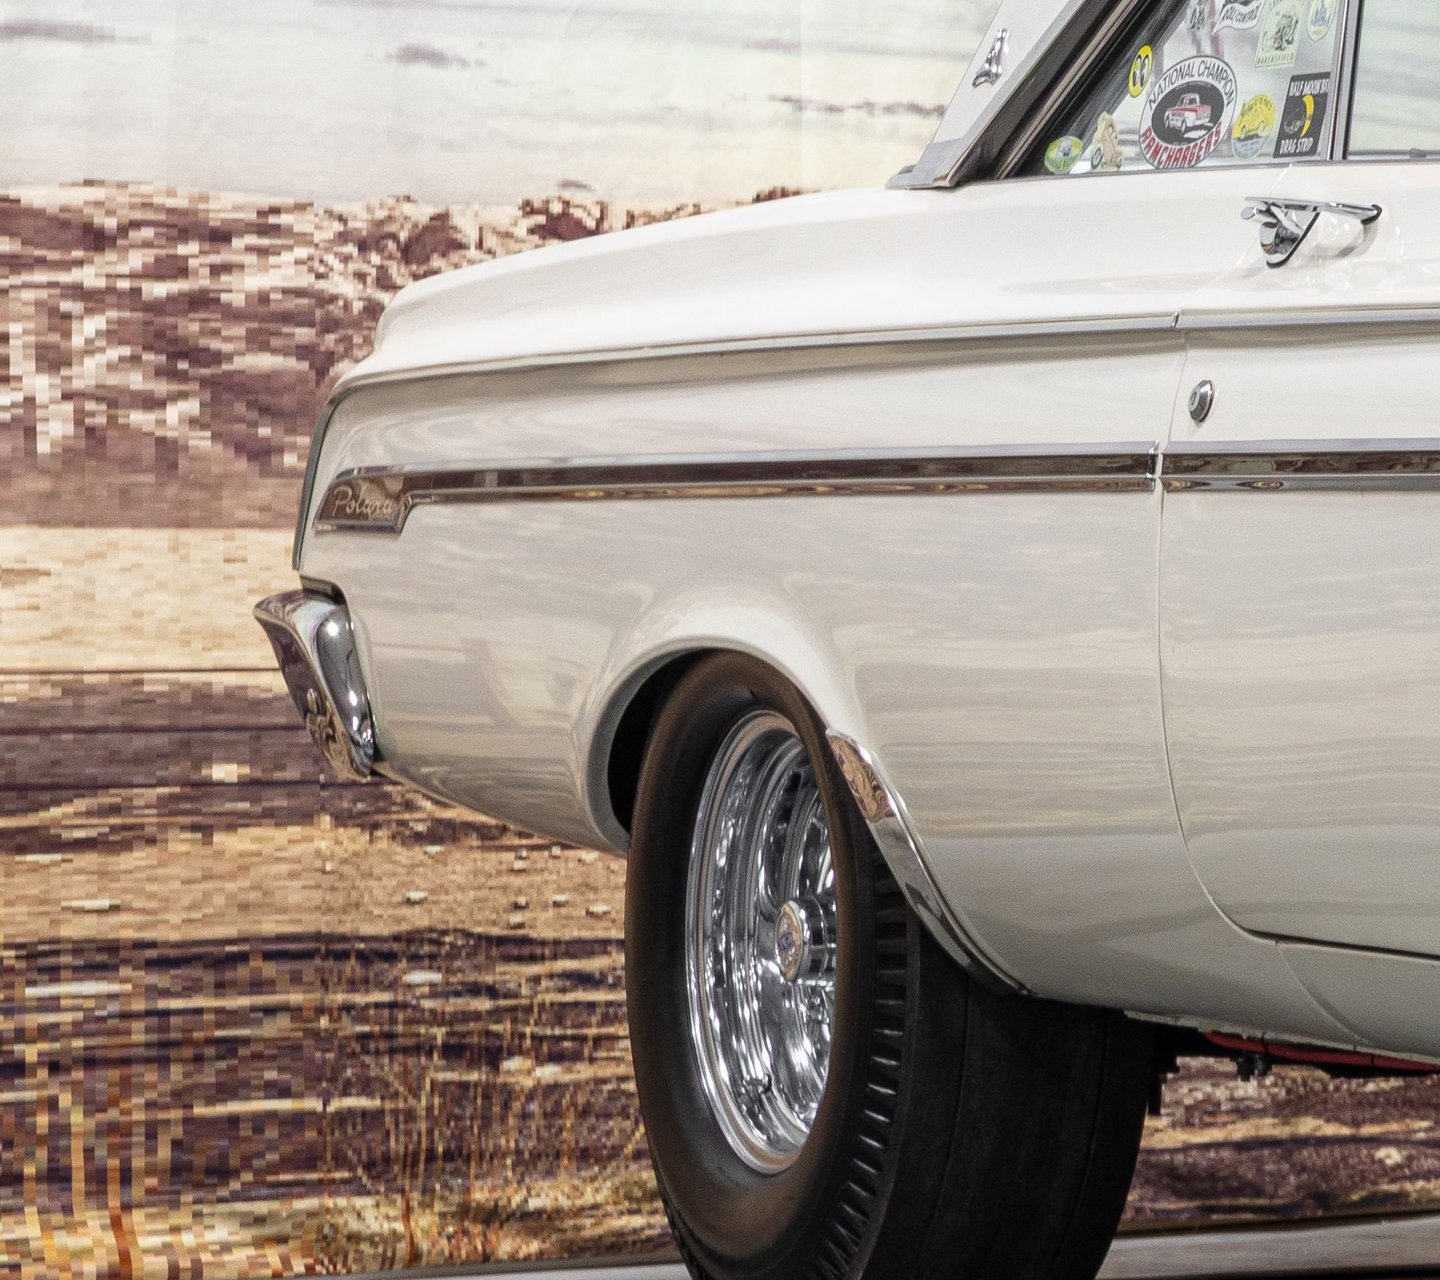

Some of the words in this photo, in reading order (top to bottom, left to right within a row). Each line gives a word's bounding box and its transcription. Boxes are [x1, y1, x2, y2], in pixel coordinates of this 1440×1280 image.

[1149, 63, 1195, 111] NATIONAL
[1197, 59, 1236, 108] CHAMPION
[1140, 121, 1222, 169] RAMCHARGERS
[1280, 138, 1297, 154] DRAG
[1296, 137, 1314, 153] STRIP
[333, 480, 393, 517] Polara
